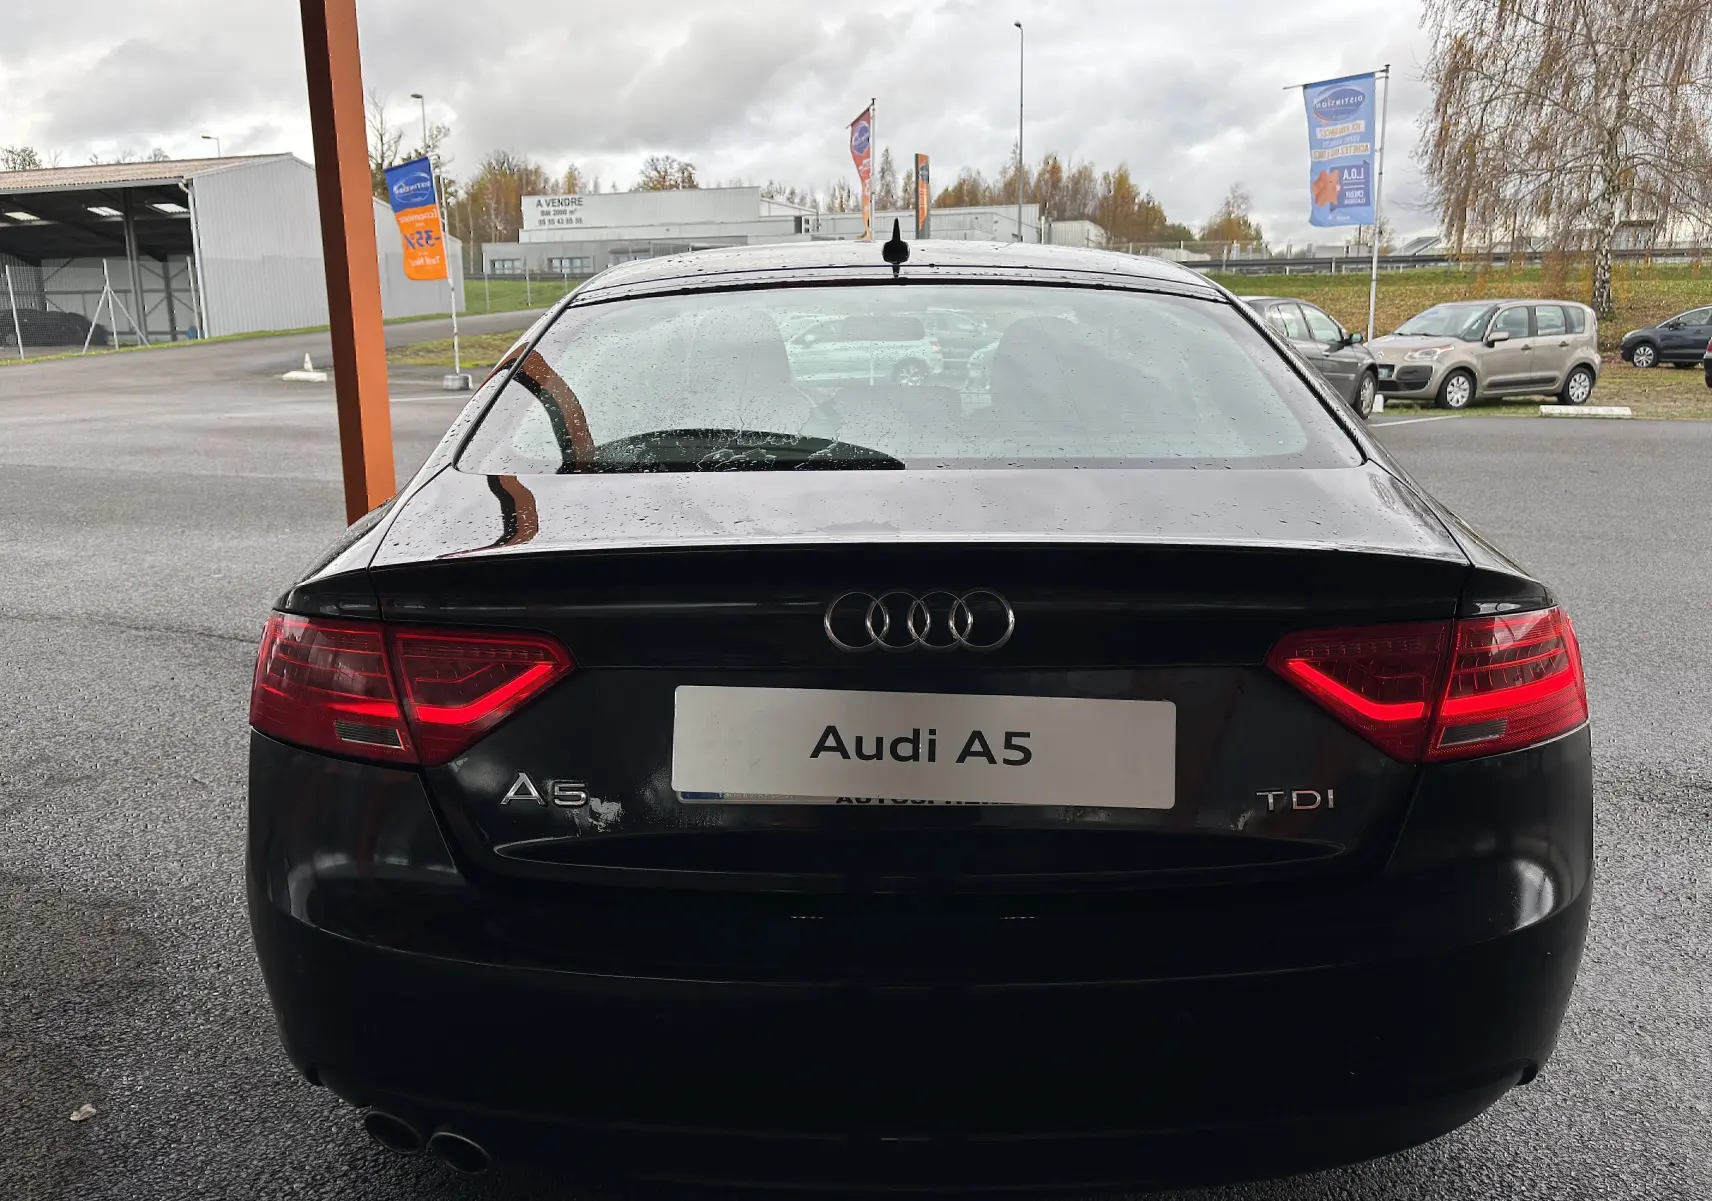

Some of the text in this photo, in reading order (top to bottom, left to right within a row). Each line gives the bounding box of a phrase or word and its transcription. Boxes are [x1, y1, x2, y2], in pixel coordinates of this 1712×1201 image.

[536, 197, 583, 208] A VENDRE
[809, 725, 1033, 766] Audi A5
[500, 772, 587, 806] A5
[1256, 789, 1334, 810] TDI
